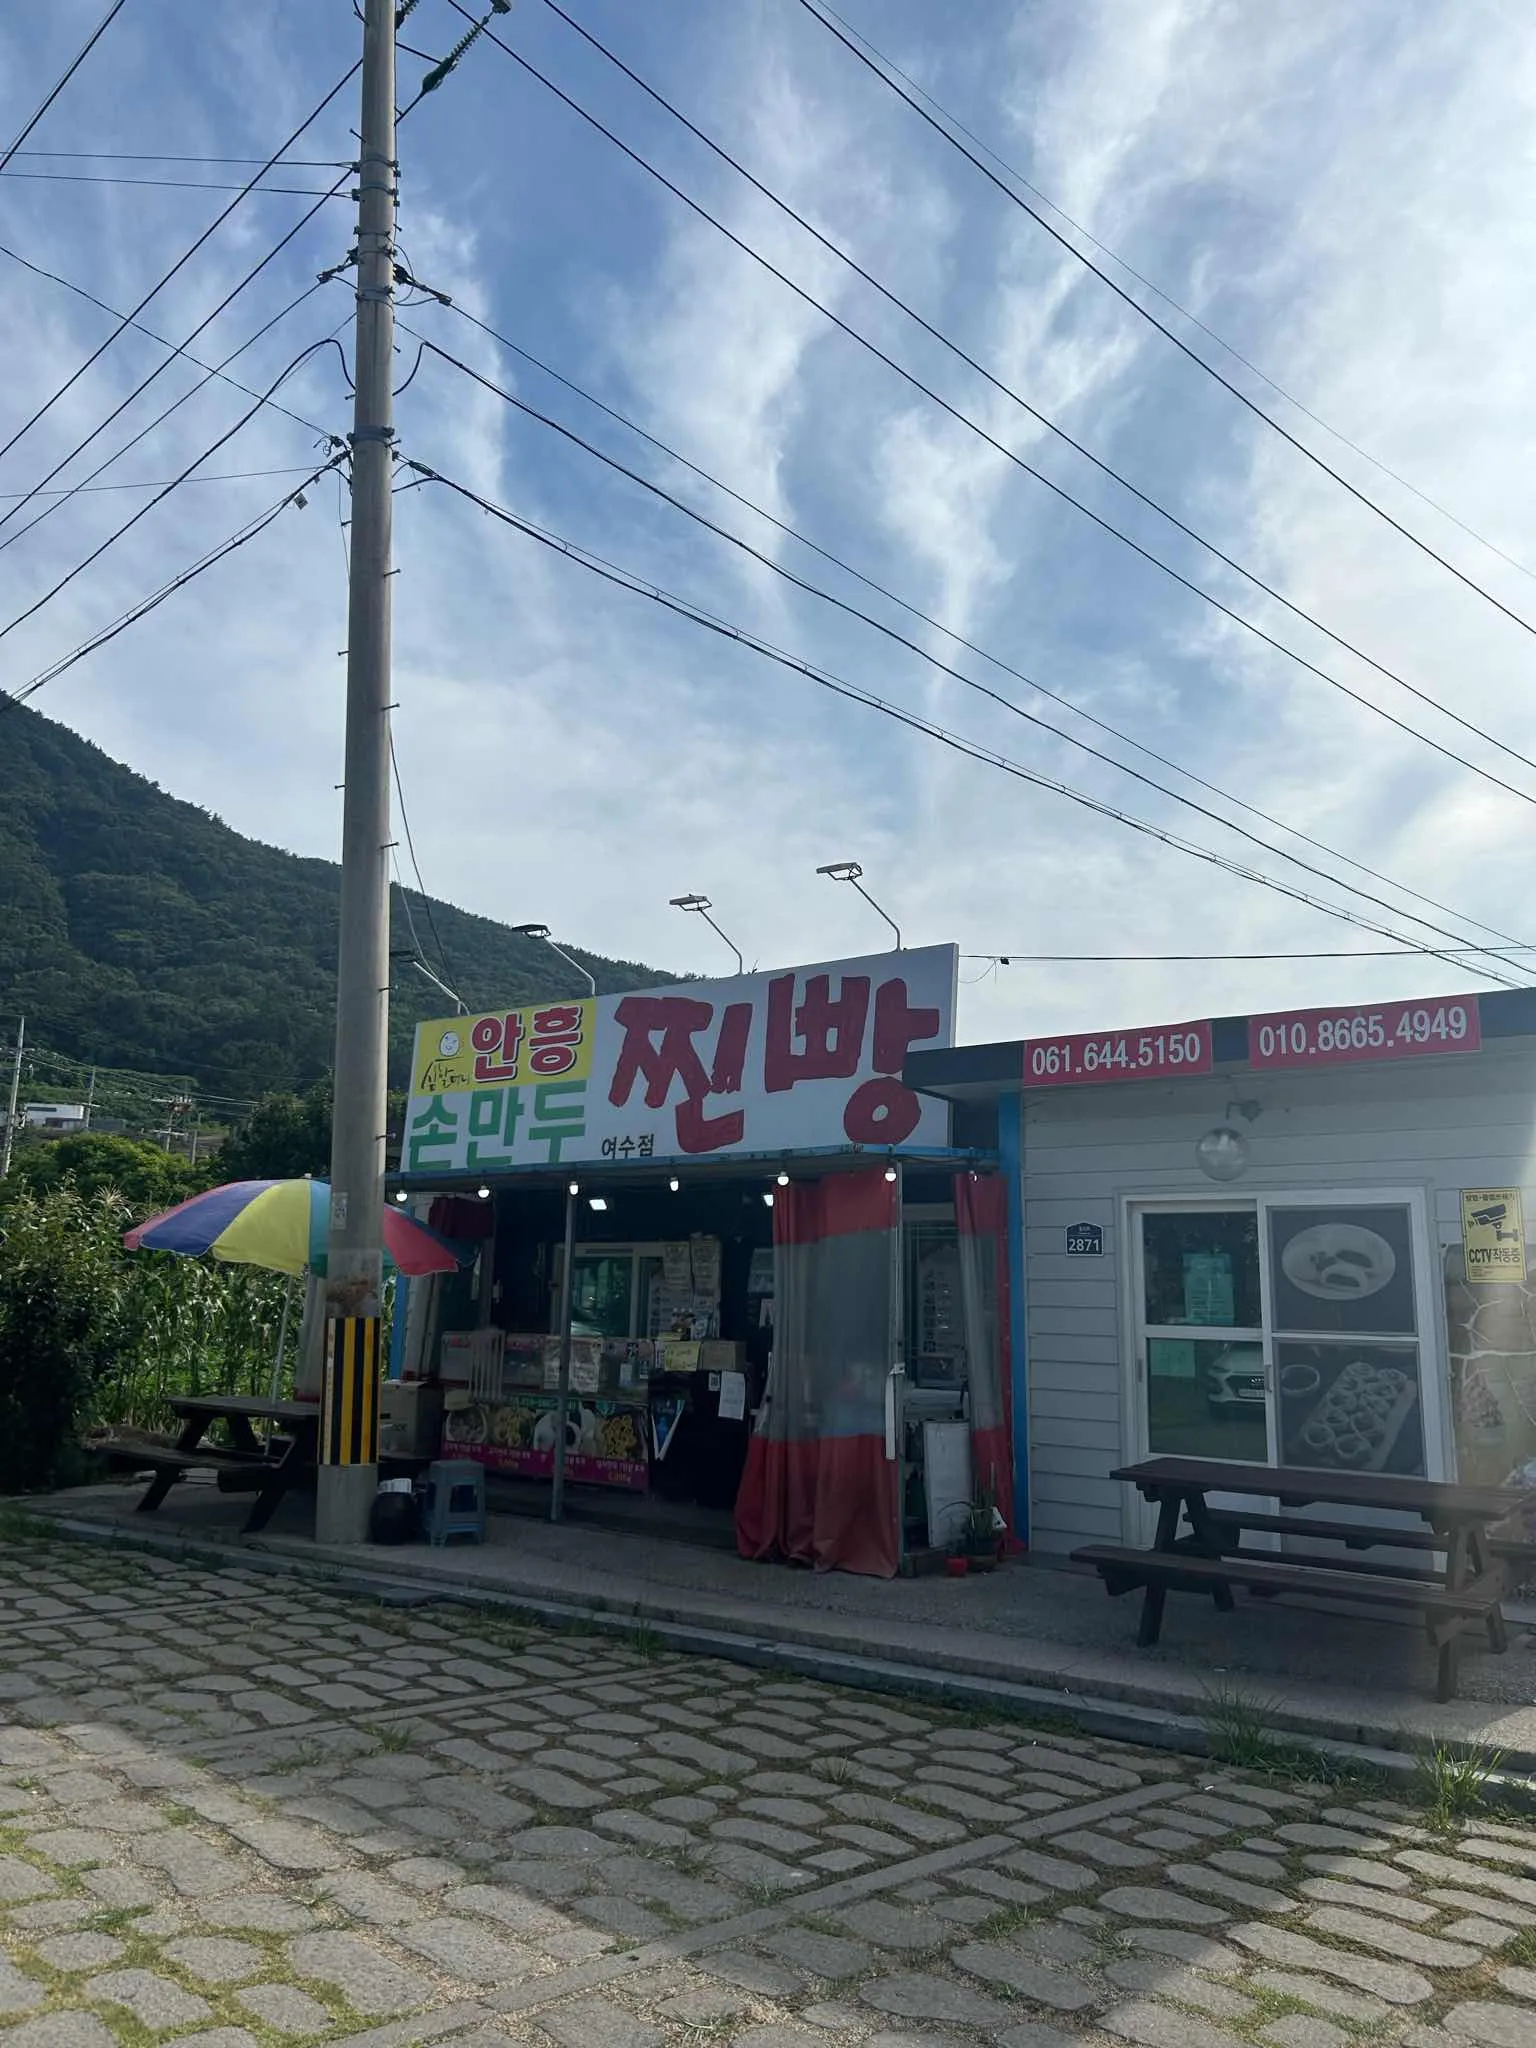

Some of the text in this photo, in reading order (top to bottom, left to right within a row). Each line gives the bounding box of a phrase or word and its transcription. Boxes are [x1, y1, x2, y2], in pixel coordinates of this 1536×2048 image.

[470, 1003, 583, 1085] 안흥
[1032, 1032, 1201, 1075] 061.644.5150
[1258, 1005, 1467, 1057] 010.8665.4949
[608, 973, 940, 1154] 찐빵
[408, 1081, 587, 1172] 손만두
[601, 1133, 655, 1160] 여수점
[1068, 1238, 1100, 1252] 2871
